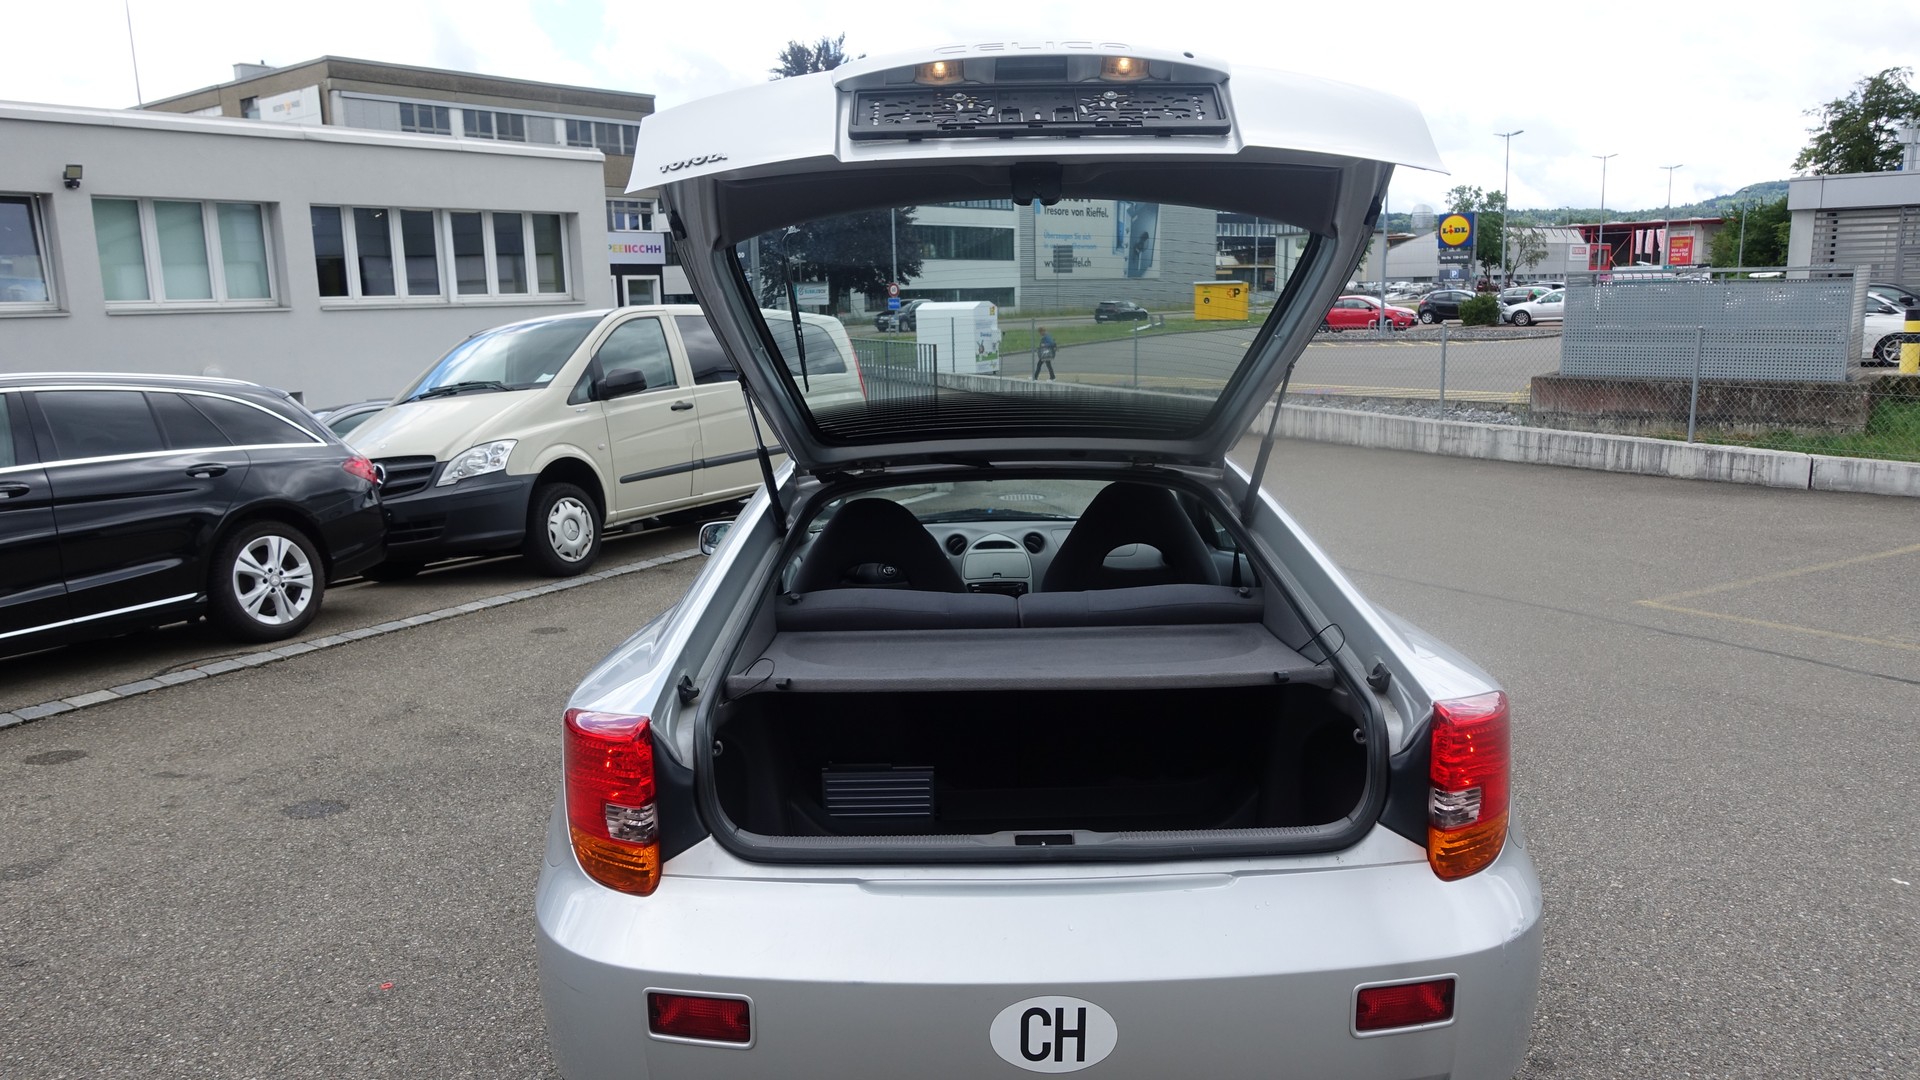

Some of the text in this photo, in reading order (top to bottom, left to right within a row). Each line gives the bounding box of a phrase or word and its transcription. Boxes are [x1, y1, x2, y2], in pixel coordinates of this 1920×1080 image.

[1044, 206, 1069, 216] Tresore
[1071, 209, 1084, 217] von
[1452, 270, 1458, 278] P
[1020, 1007, 1086, 1062] CH
